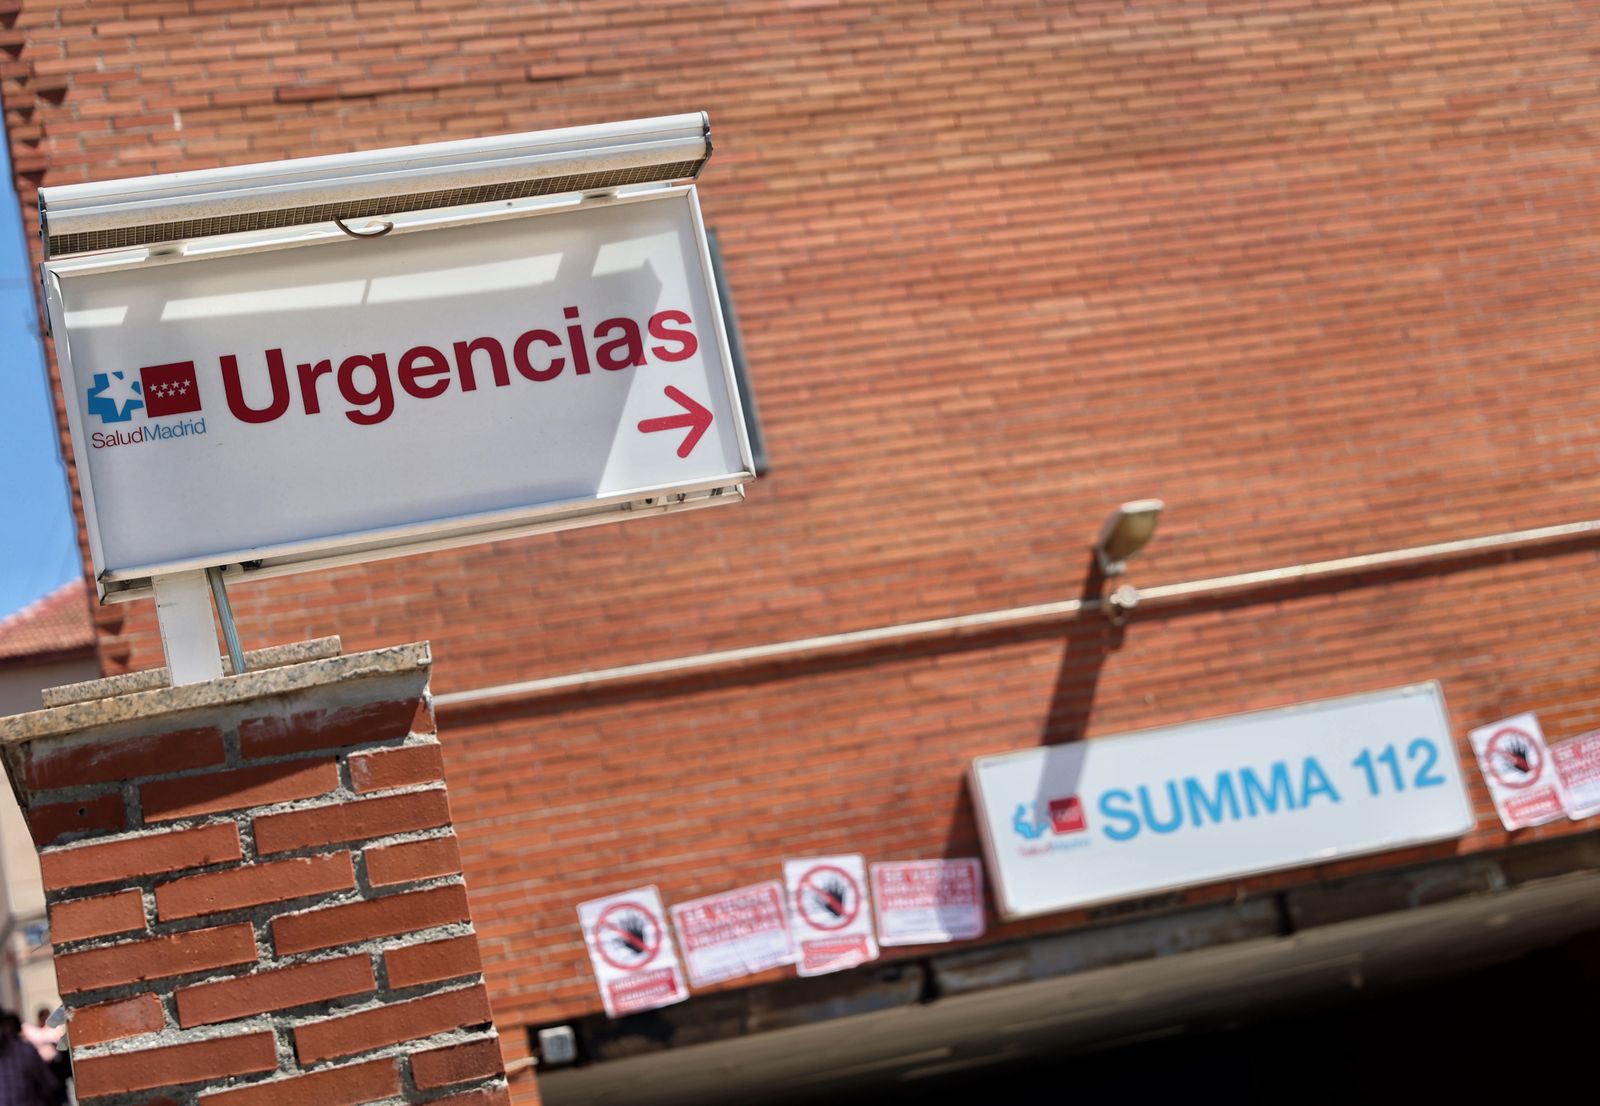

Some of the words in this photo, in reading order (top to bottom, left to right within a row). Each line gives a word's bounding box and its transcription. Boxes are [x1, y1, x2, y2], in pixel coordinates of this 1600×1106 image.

[219, 306, 698, 426] Urgencias
[91, 417, 207, 449] SaludMadrid
[1097, 756, 1341, 842] SUMMA
[1352, 737, 1447, 796] 112
